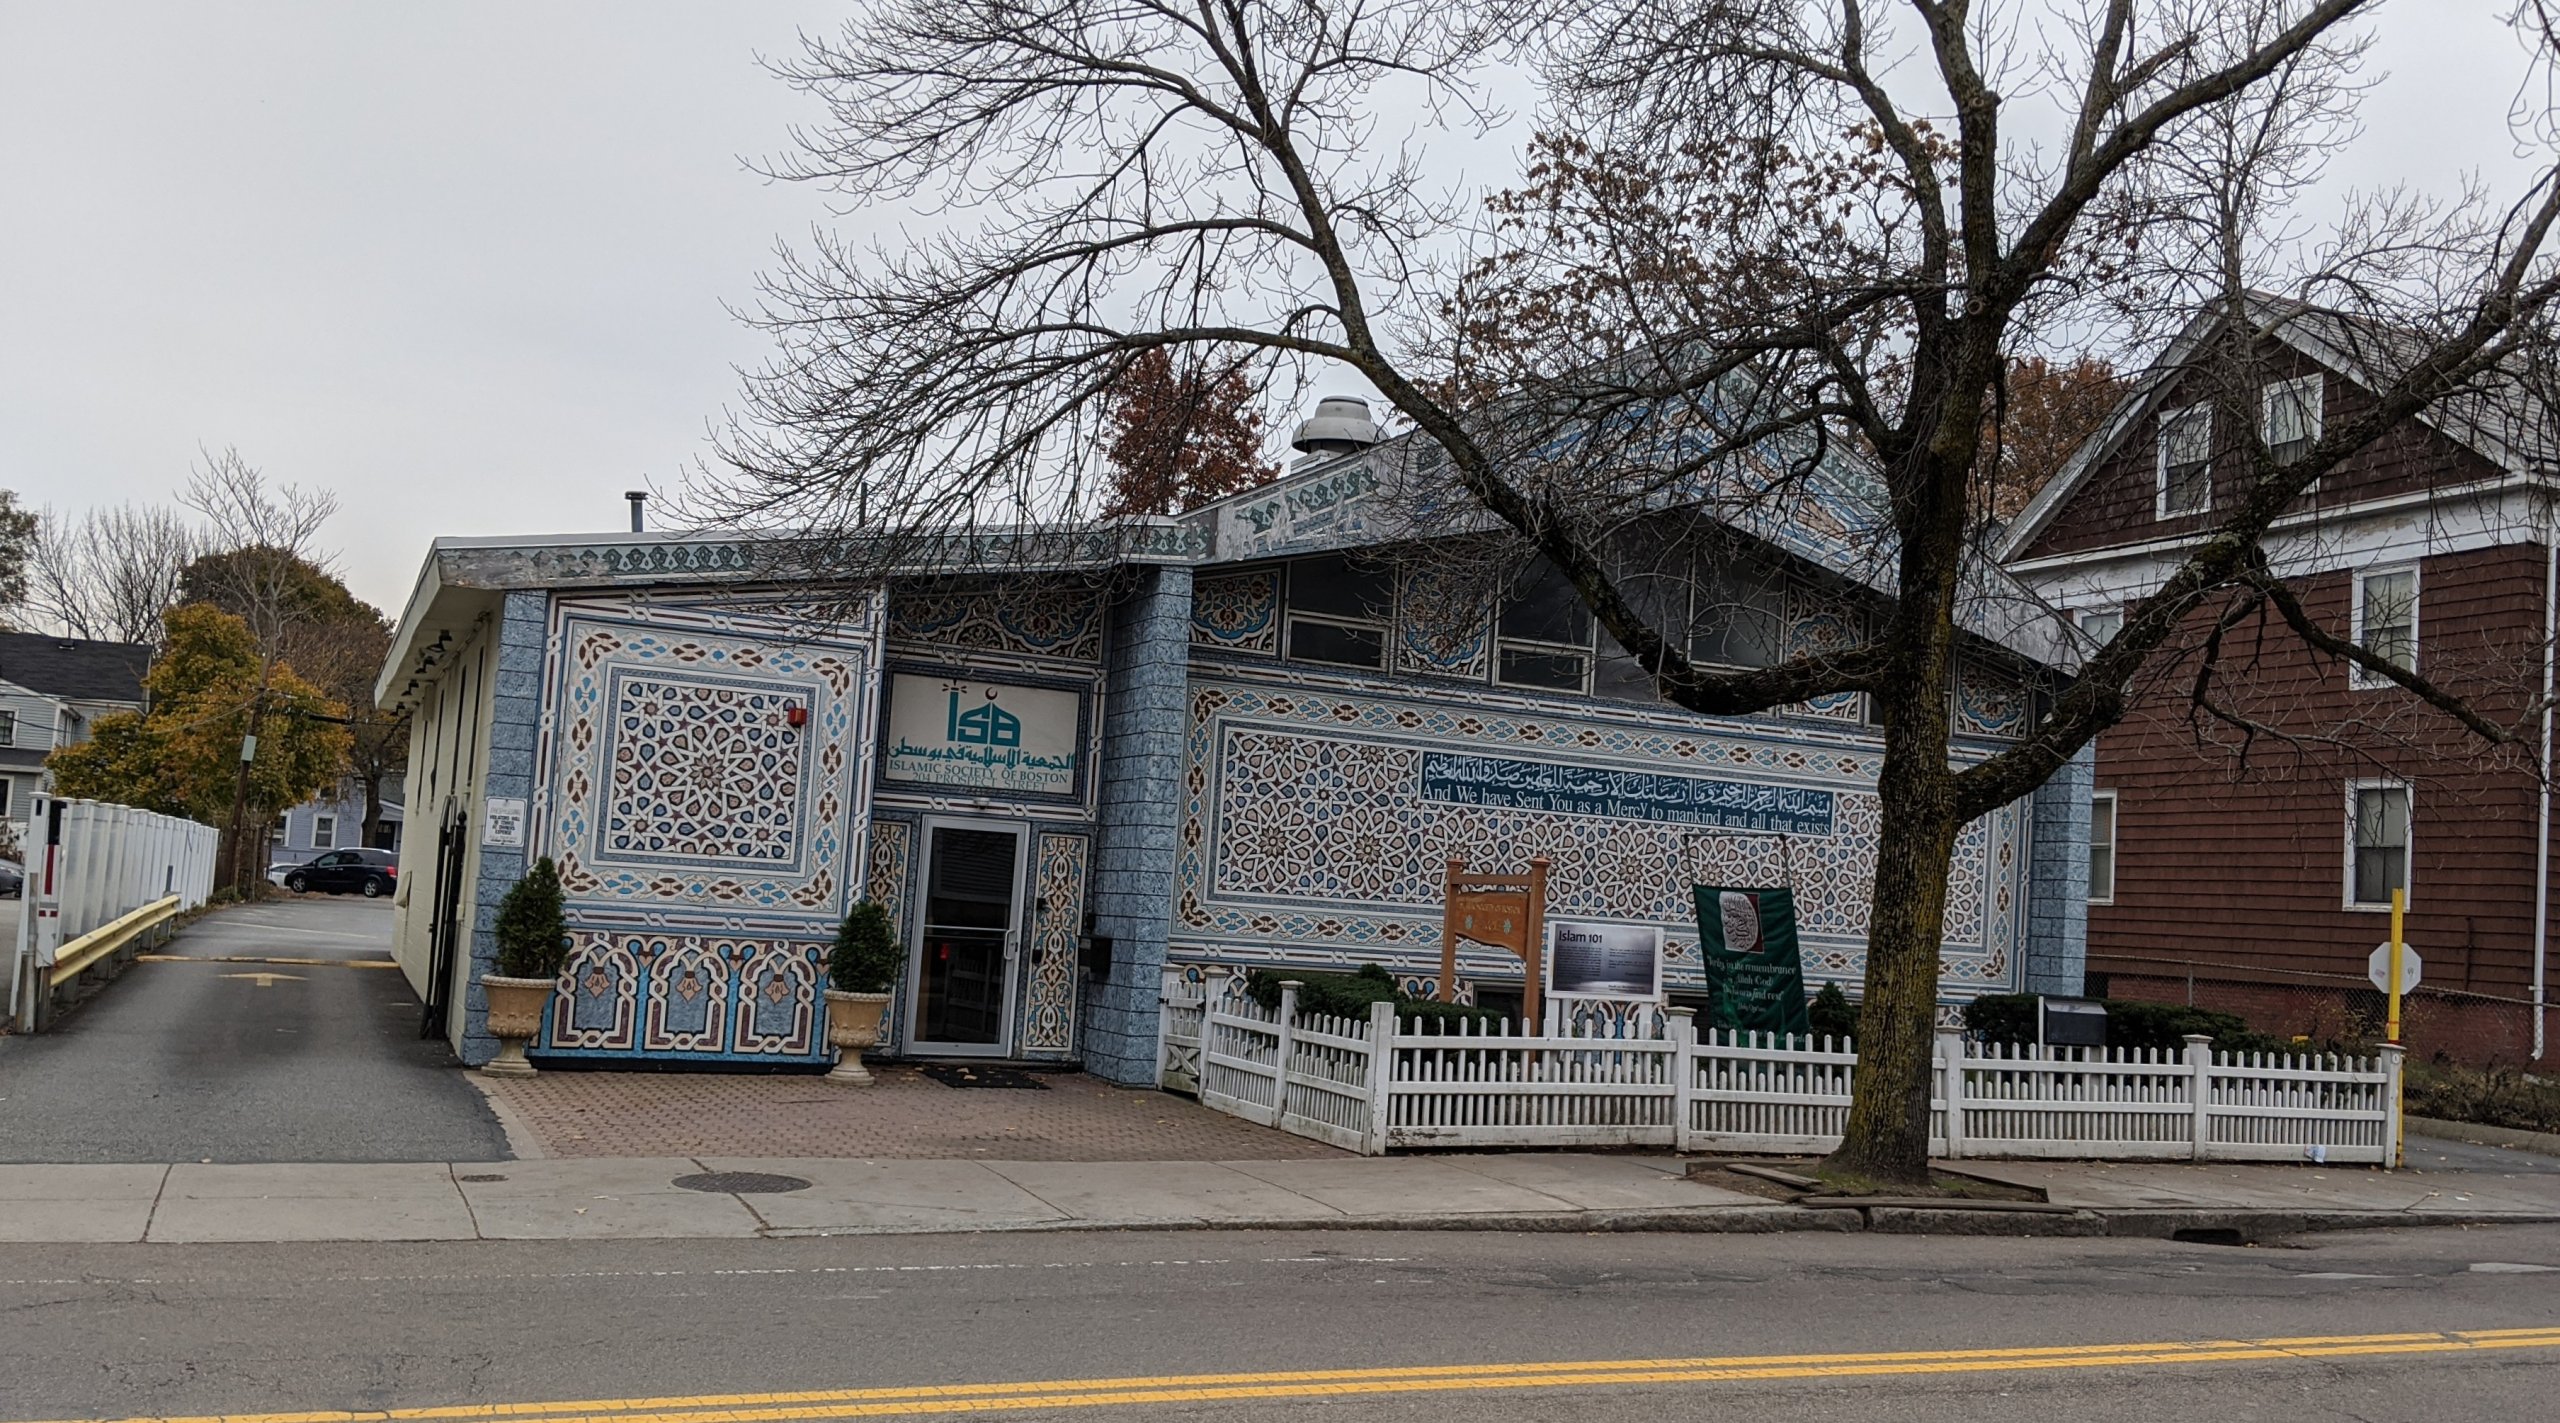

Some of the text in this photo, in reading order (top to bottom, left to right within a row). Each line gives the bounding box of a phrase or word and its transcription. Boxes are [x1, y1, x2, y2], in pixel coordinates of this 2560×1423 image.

[888, 736, 943, 762] بوسطن
[942, 744, 966, 763] في
[889, 760, 1068, 784] ISLAMIC SOCIETY OF BOSTON
[1021, 752, 1076, 773] الجمعية
[912, 772, 1048, 792] 204 PROSPECT STREET
[1421, 782, 1830, 836] And We have Sent You as a Mercy to mankind and all that exists
[1559, 930, 1603, 944] Islam 101
[1745, 963, 1796, 976] remembrance
